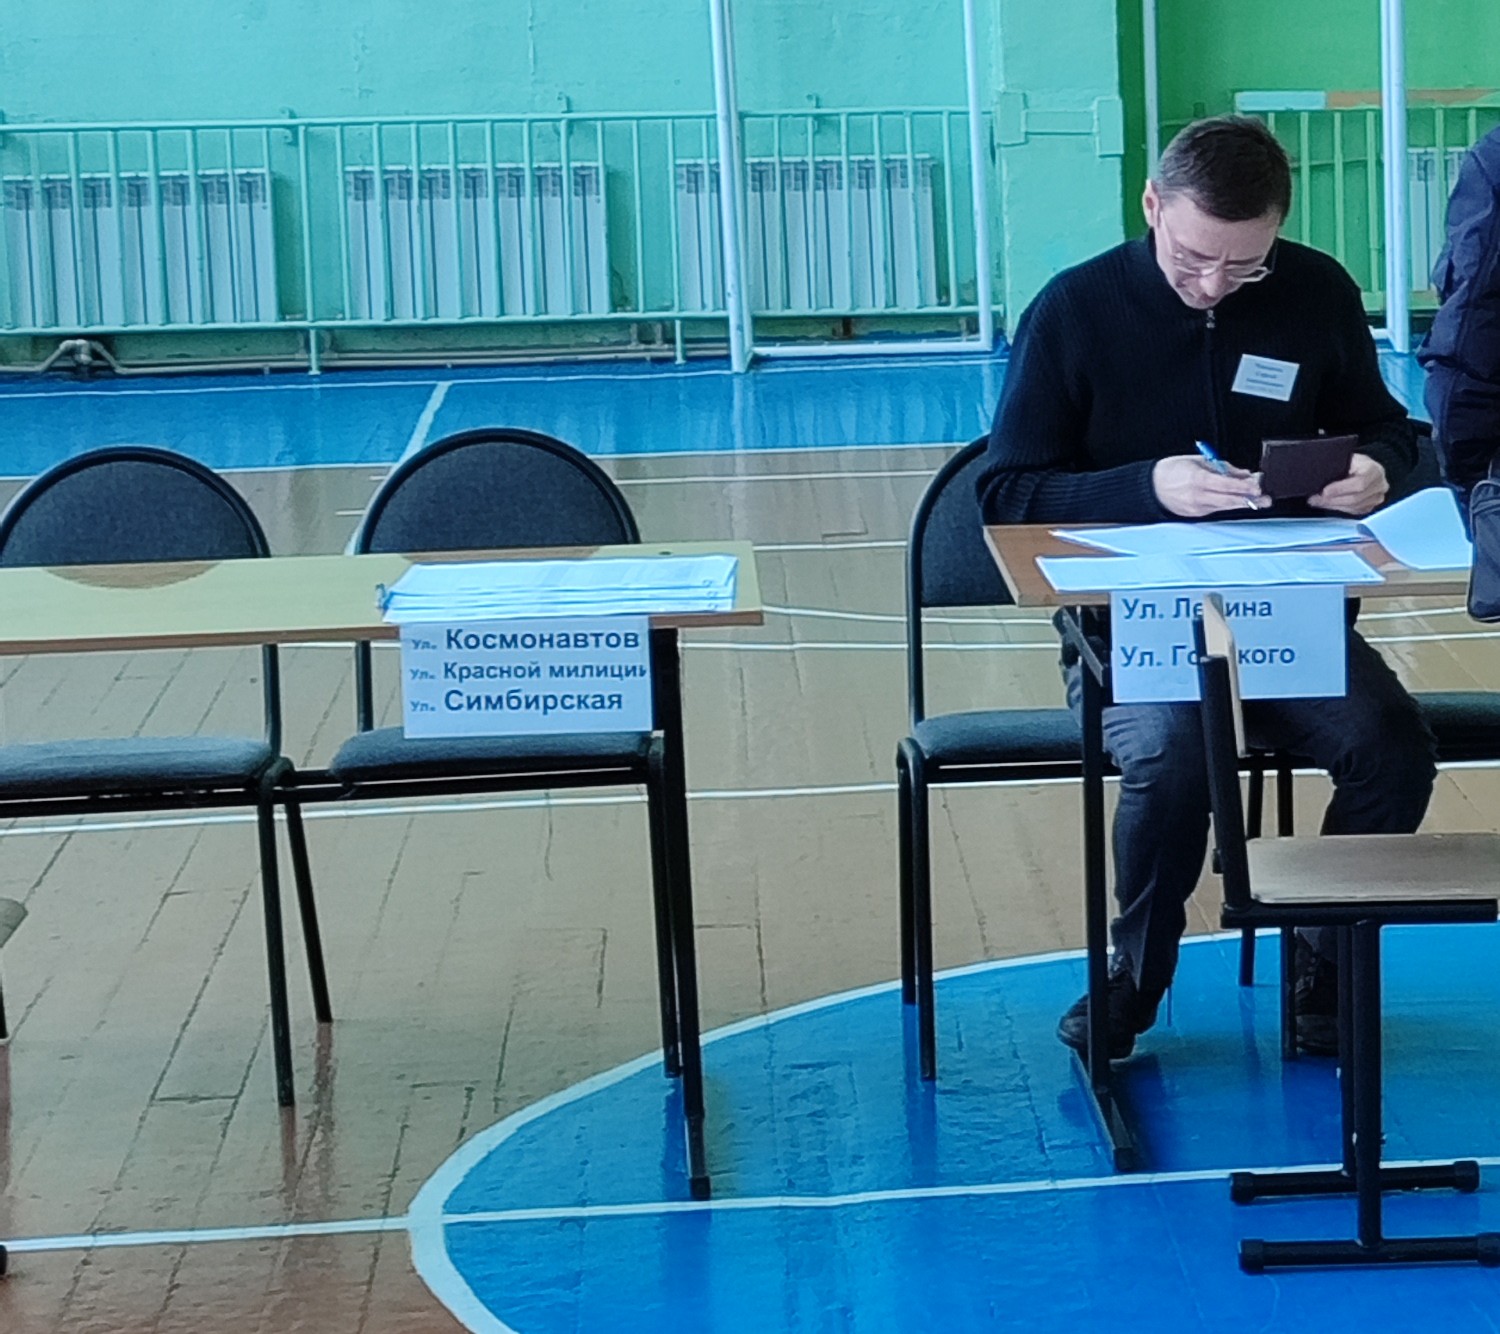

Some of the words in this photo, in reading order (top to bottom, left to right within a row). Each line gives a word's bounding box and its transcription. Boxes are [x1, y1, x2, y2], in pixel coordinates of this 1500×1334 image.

[1120, 598, 1165, 619] Ул.
[1172, 597, 1273, 618] Леина
[446, 628, 640, 650] Космонавтов
[1119, 646, 1163, 667] Ул.
[1172, 645, 1296, 666] Гокого
[443, 661, 541, 683] Красной
[444, 689, 623, 716] Симбирская
